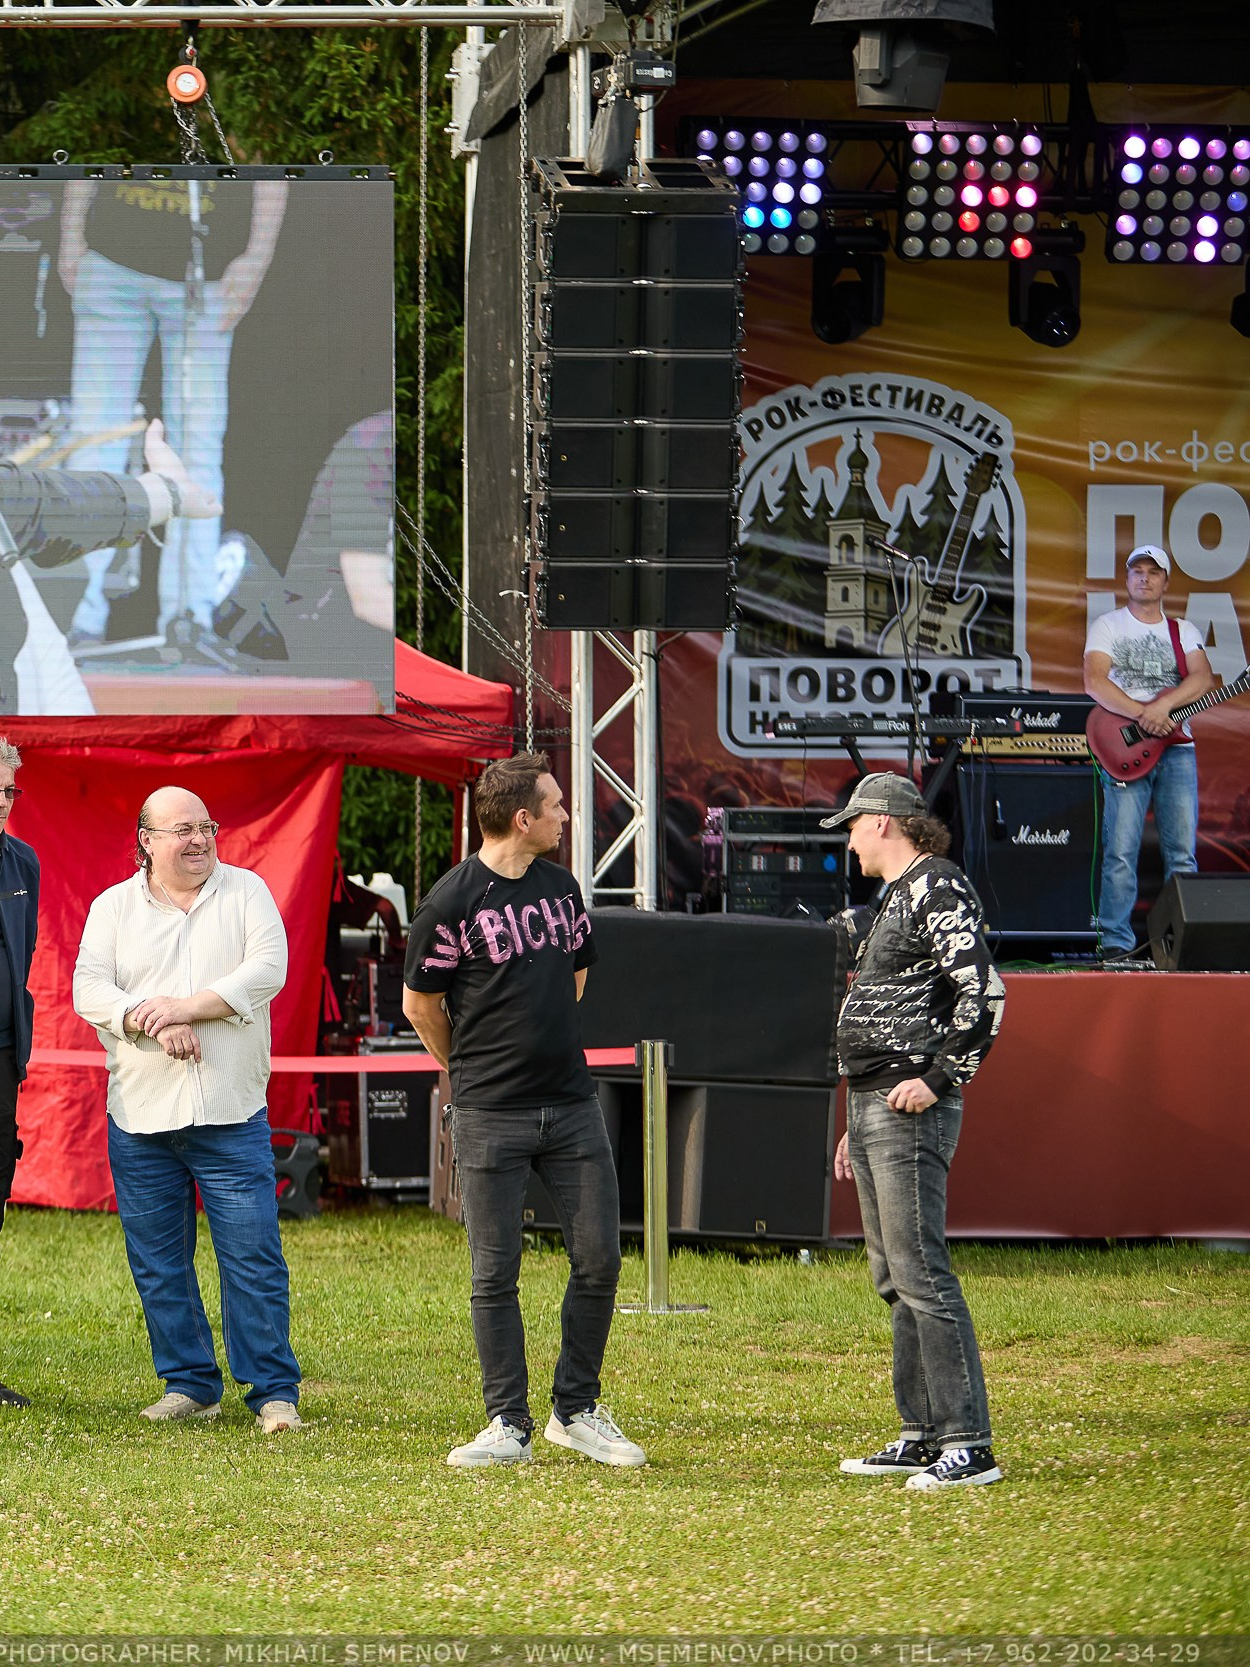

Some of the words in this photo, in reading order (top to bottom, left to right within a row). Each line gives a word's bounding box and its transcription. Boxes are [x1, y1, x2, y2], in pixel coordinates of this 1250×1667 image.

[743, 382, 1005, 450] РОК-ФЕСТИВАЛЬ
[1086, 482, 1250, 582] ПО
[748, 665, 1002, 703] ПОВОРОТ
[1011, 824, 1070, 845] Marshall
